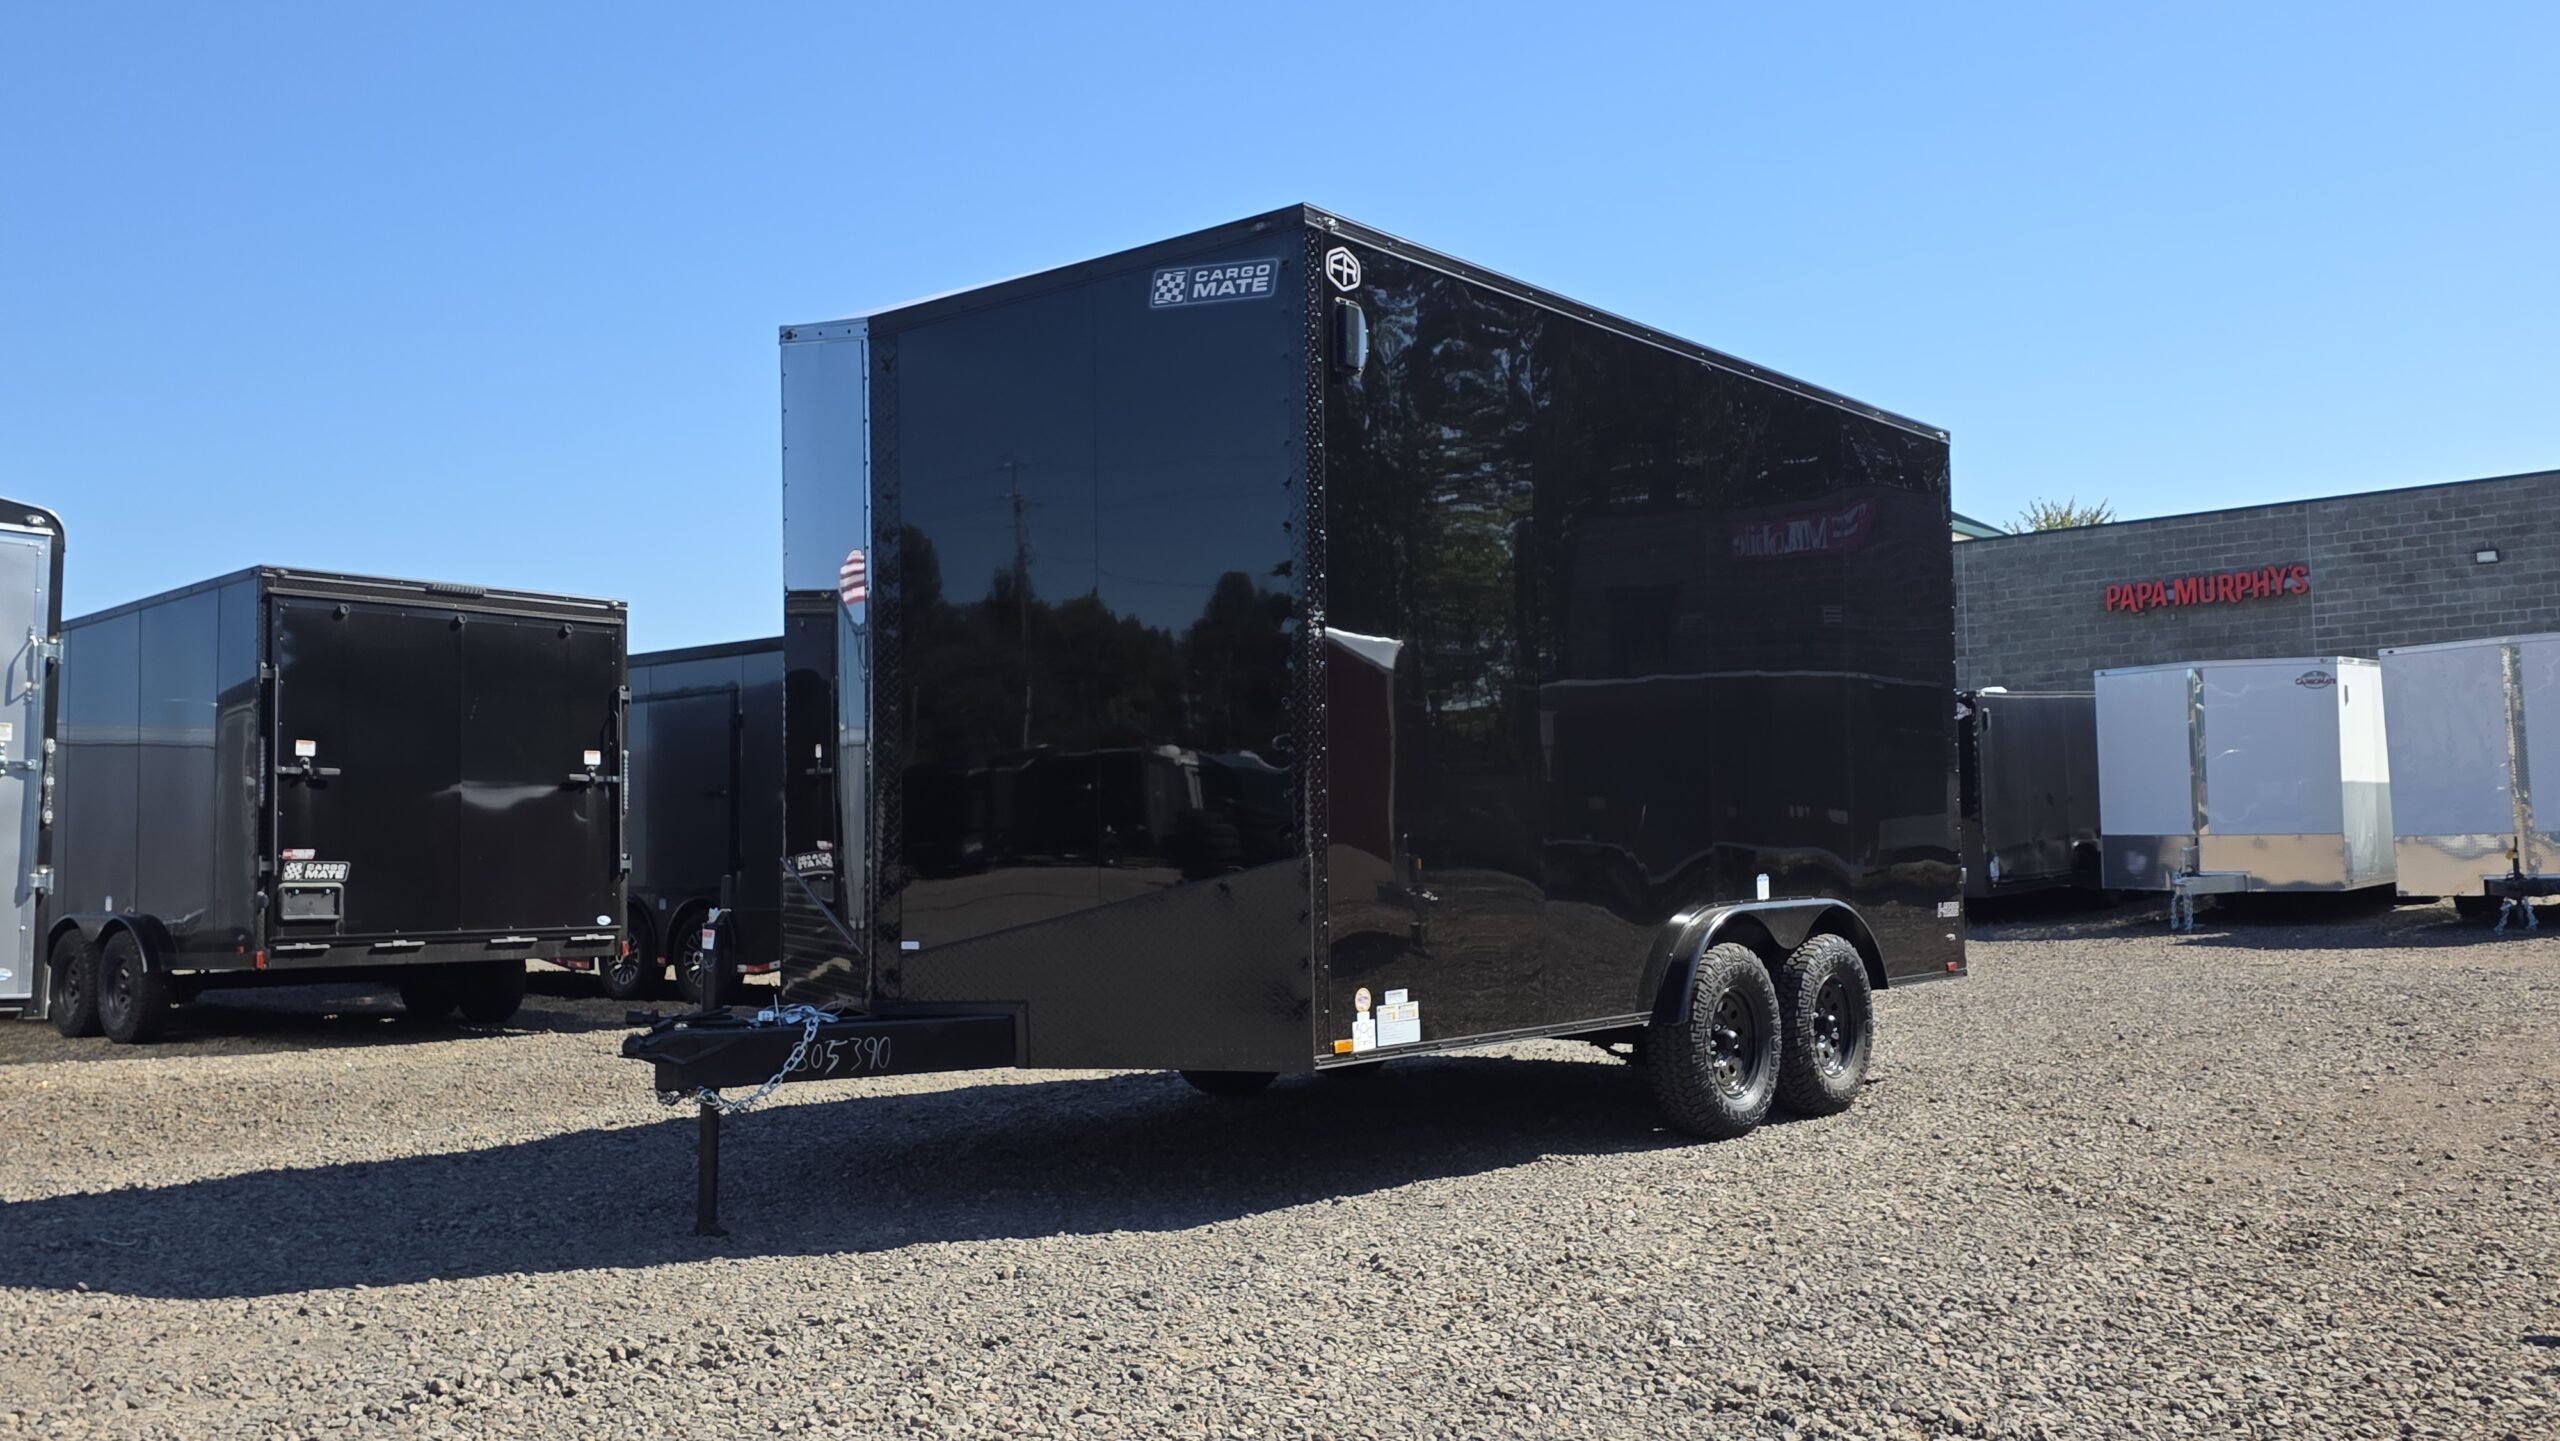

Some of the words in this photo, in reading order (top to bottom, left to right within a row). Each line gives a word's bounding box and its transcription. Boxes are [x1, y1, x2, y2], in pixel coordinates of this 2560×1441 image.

[1194, 264, 1271, 282] CARGO
[1192, 276, 1269, 299] MATE
[2105, 580, 2168, 613] PAPA
[2173, 563, 2310, 605] MURPHY'S
[304, 870, 346, 880] MATE
